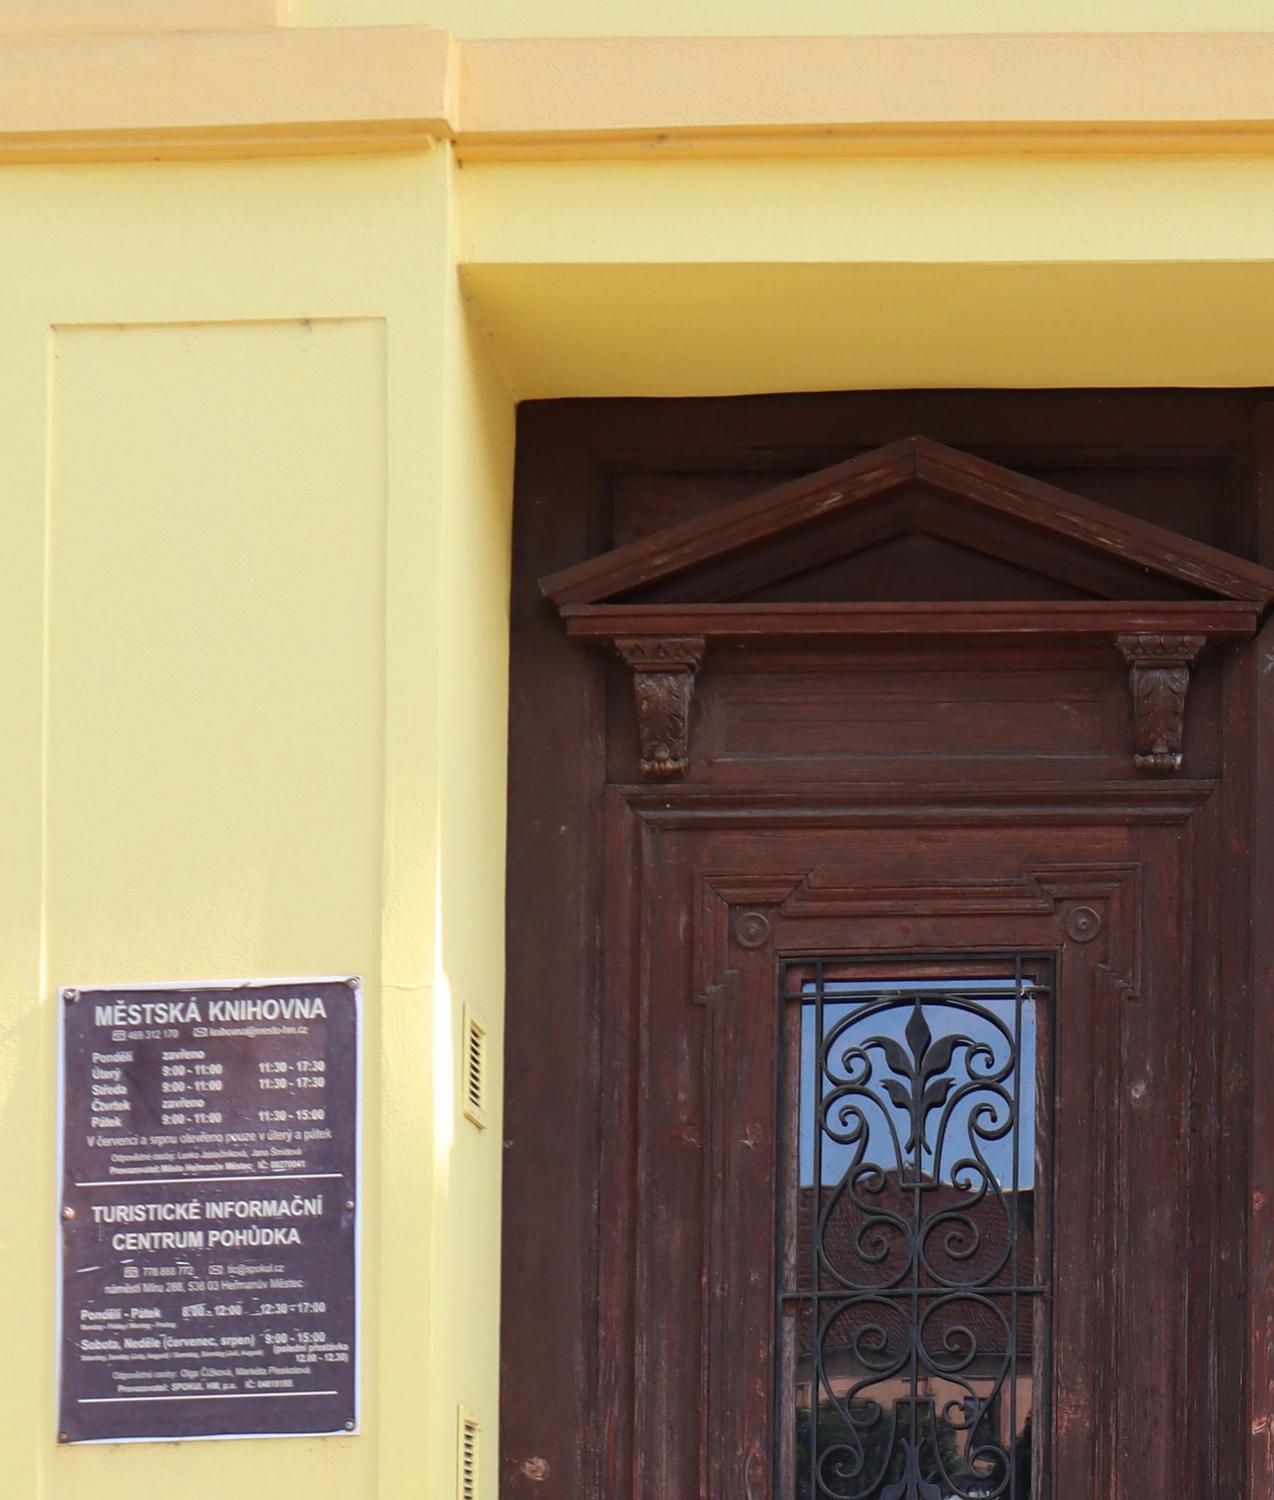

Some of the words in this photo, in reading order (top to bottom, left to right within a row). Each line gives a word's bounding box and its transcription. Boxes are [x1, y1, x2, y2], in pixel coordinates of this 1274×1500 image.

[95, 996, 202, 1027] MĚSTSKÁ
[208, 998, 327, 1021] KNIHOVNA
[92, 1050, 134, 1063] Pondělí
[161, 1048, 206, 1061] zavřeno
[92, 1066, 122, 1081] Úterý
[161, 1065, 186, 1076] 9:00
[194, 1063, 223, 1075] 11:00
[258, 1062, 288, 1073] 11:30
[296, 1060, 326, 1072] 17:30
[91, 1084, 128, 1096] Středa
[161, 1081, 186, 1093] 9:00
[194, 1080, 223, 1091] 11:00
[258, 1078, 288, 1089] 11:30
[296, 1076, 326, 1088] 17:30
[91, 1098, 131, 1112] Čtvrtek
[161, 1097, 206, 1109] zavřeno
[91, 1115, 123, 1128] Pátek
[161, 1113, 186, 1125] 9:00
[194, 1112, 223, 1123] 11:00
[258, 1110, 288, 1121] 11:30
[296, 1109, 326, 1120] 15:00
[86, 1135, 96, 1147] V
[97, 1135, 139, 1147] červenci
[140, 1136, 148, 1145] a
[149, 1135, 179, 1147] srpnu
[179, 1132, 224, 1144] otevřeno
[225, 1132, 257, 1144] pouze
[258, 1132, 266, 1141] v
[267, 1128, 293, 1142] úterý
[294, 1131, 302, 1140] a
[303, 1128, 333, 1142] pátek
[92, 1199, 202, 1224] TURISTICKÉ
[206, 1195, 323, 1219] INFORMAČNÍ
[112, 1231, 204, 1251] CENTRUM
[269, 1279, 305, 1289] Městec
[81, 1308, 123, 1321] Pondělí
[131, 1306, 162, 1319] Pátek
[214, 1304, 243, 1316] 12:00
[260, 1303, 288, 1315] 12:30
[298, 1302, 326, 1313] 17:00
[81, 1338, 122, 1351] Sobota,
[123, 1338, 161, 1349] Neděle
[162, 1335, 219, 1350] (červenec,
[220, 1333, 255, 1348] srpen)
[264, 1332, 288, 1344] 9:00
[297, 1331, 326, 1343] 15:00
